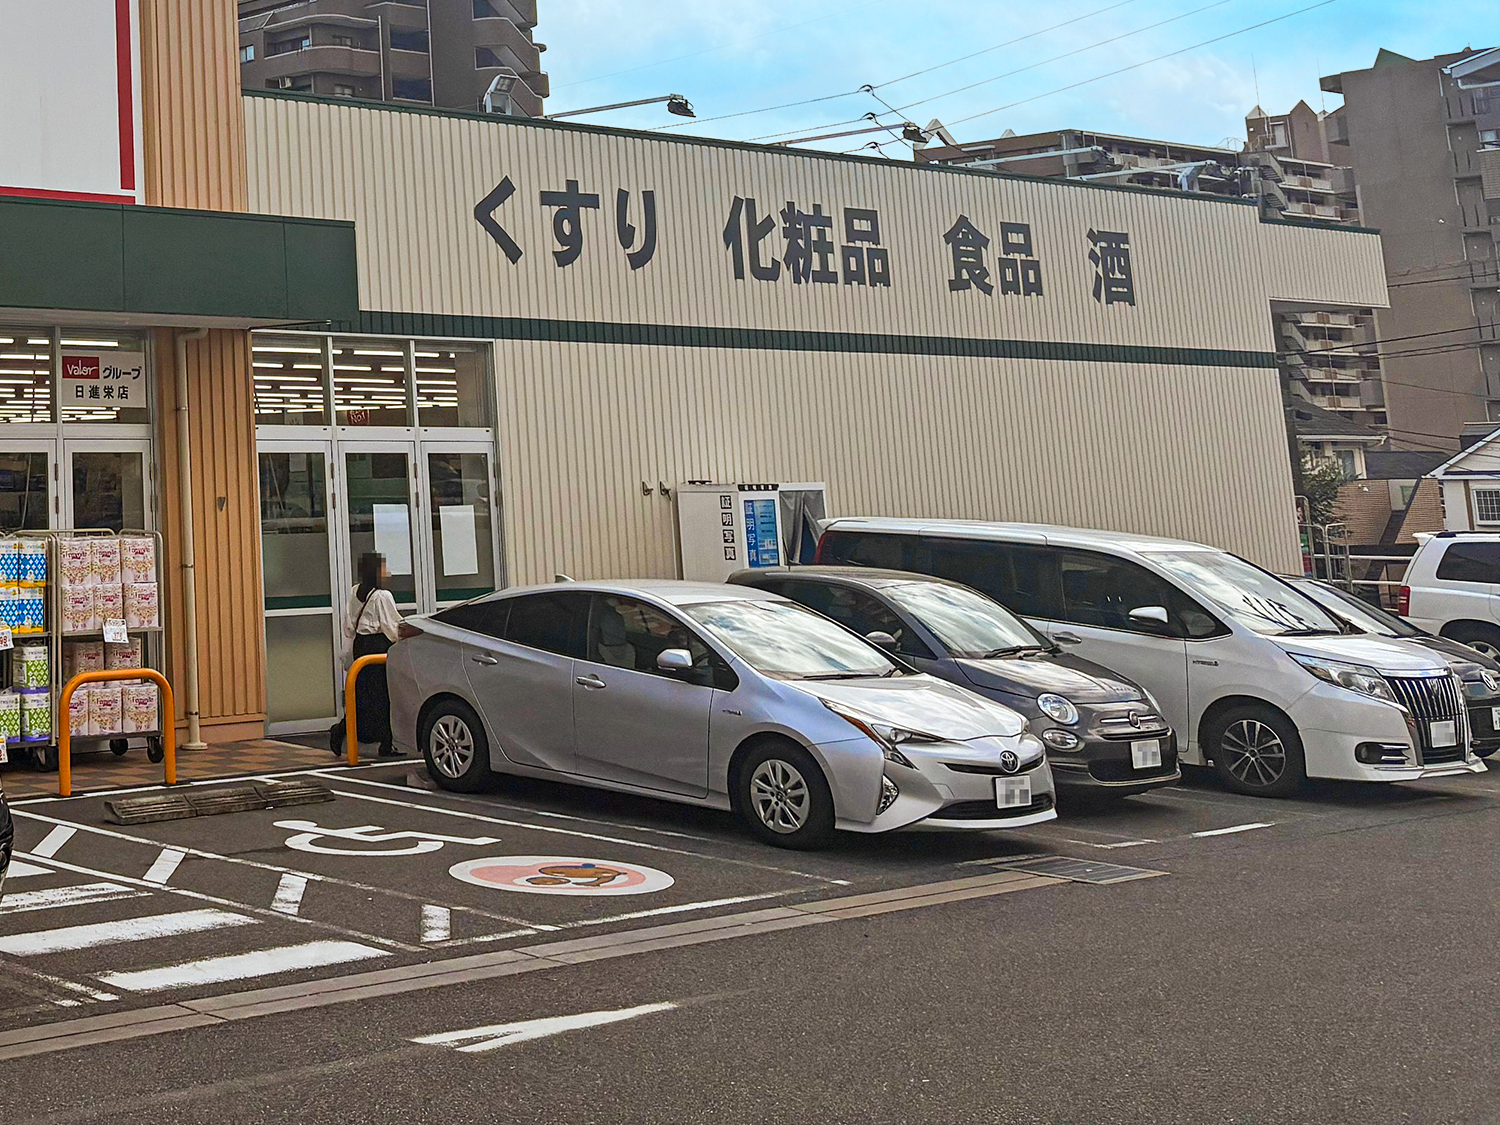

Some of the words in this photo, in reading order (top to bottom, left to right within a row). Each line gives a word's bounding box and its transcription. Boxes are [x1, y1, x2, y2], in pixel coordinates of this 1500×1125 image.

[474, 174, 655, 271] くすり
[722, 194, 892, 288] 化粧品
[943, 213, 1044, 297] 食品
[1088, 227, 1136, 307] 酒
[75, 385, 129, 399] 日進栄店
[102, 365, 143, 380] グループ
[719, 495, 737, 561] 証明写真
